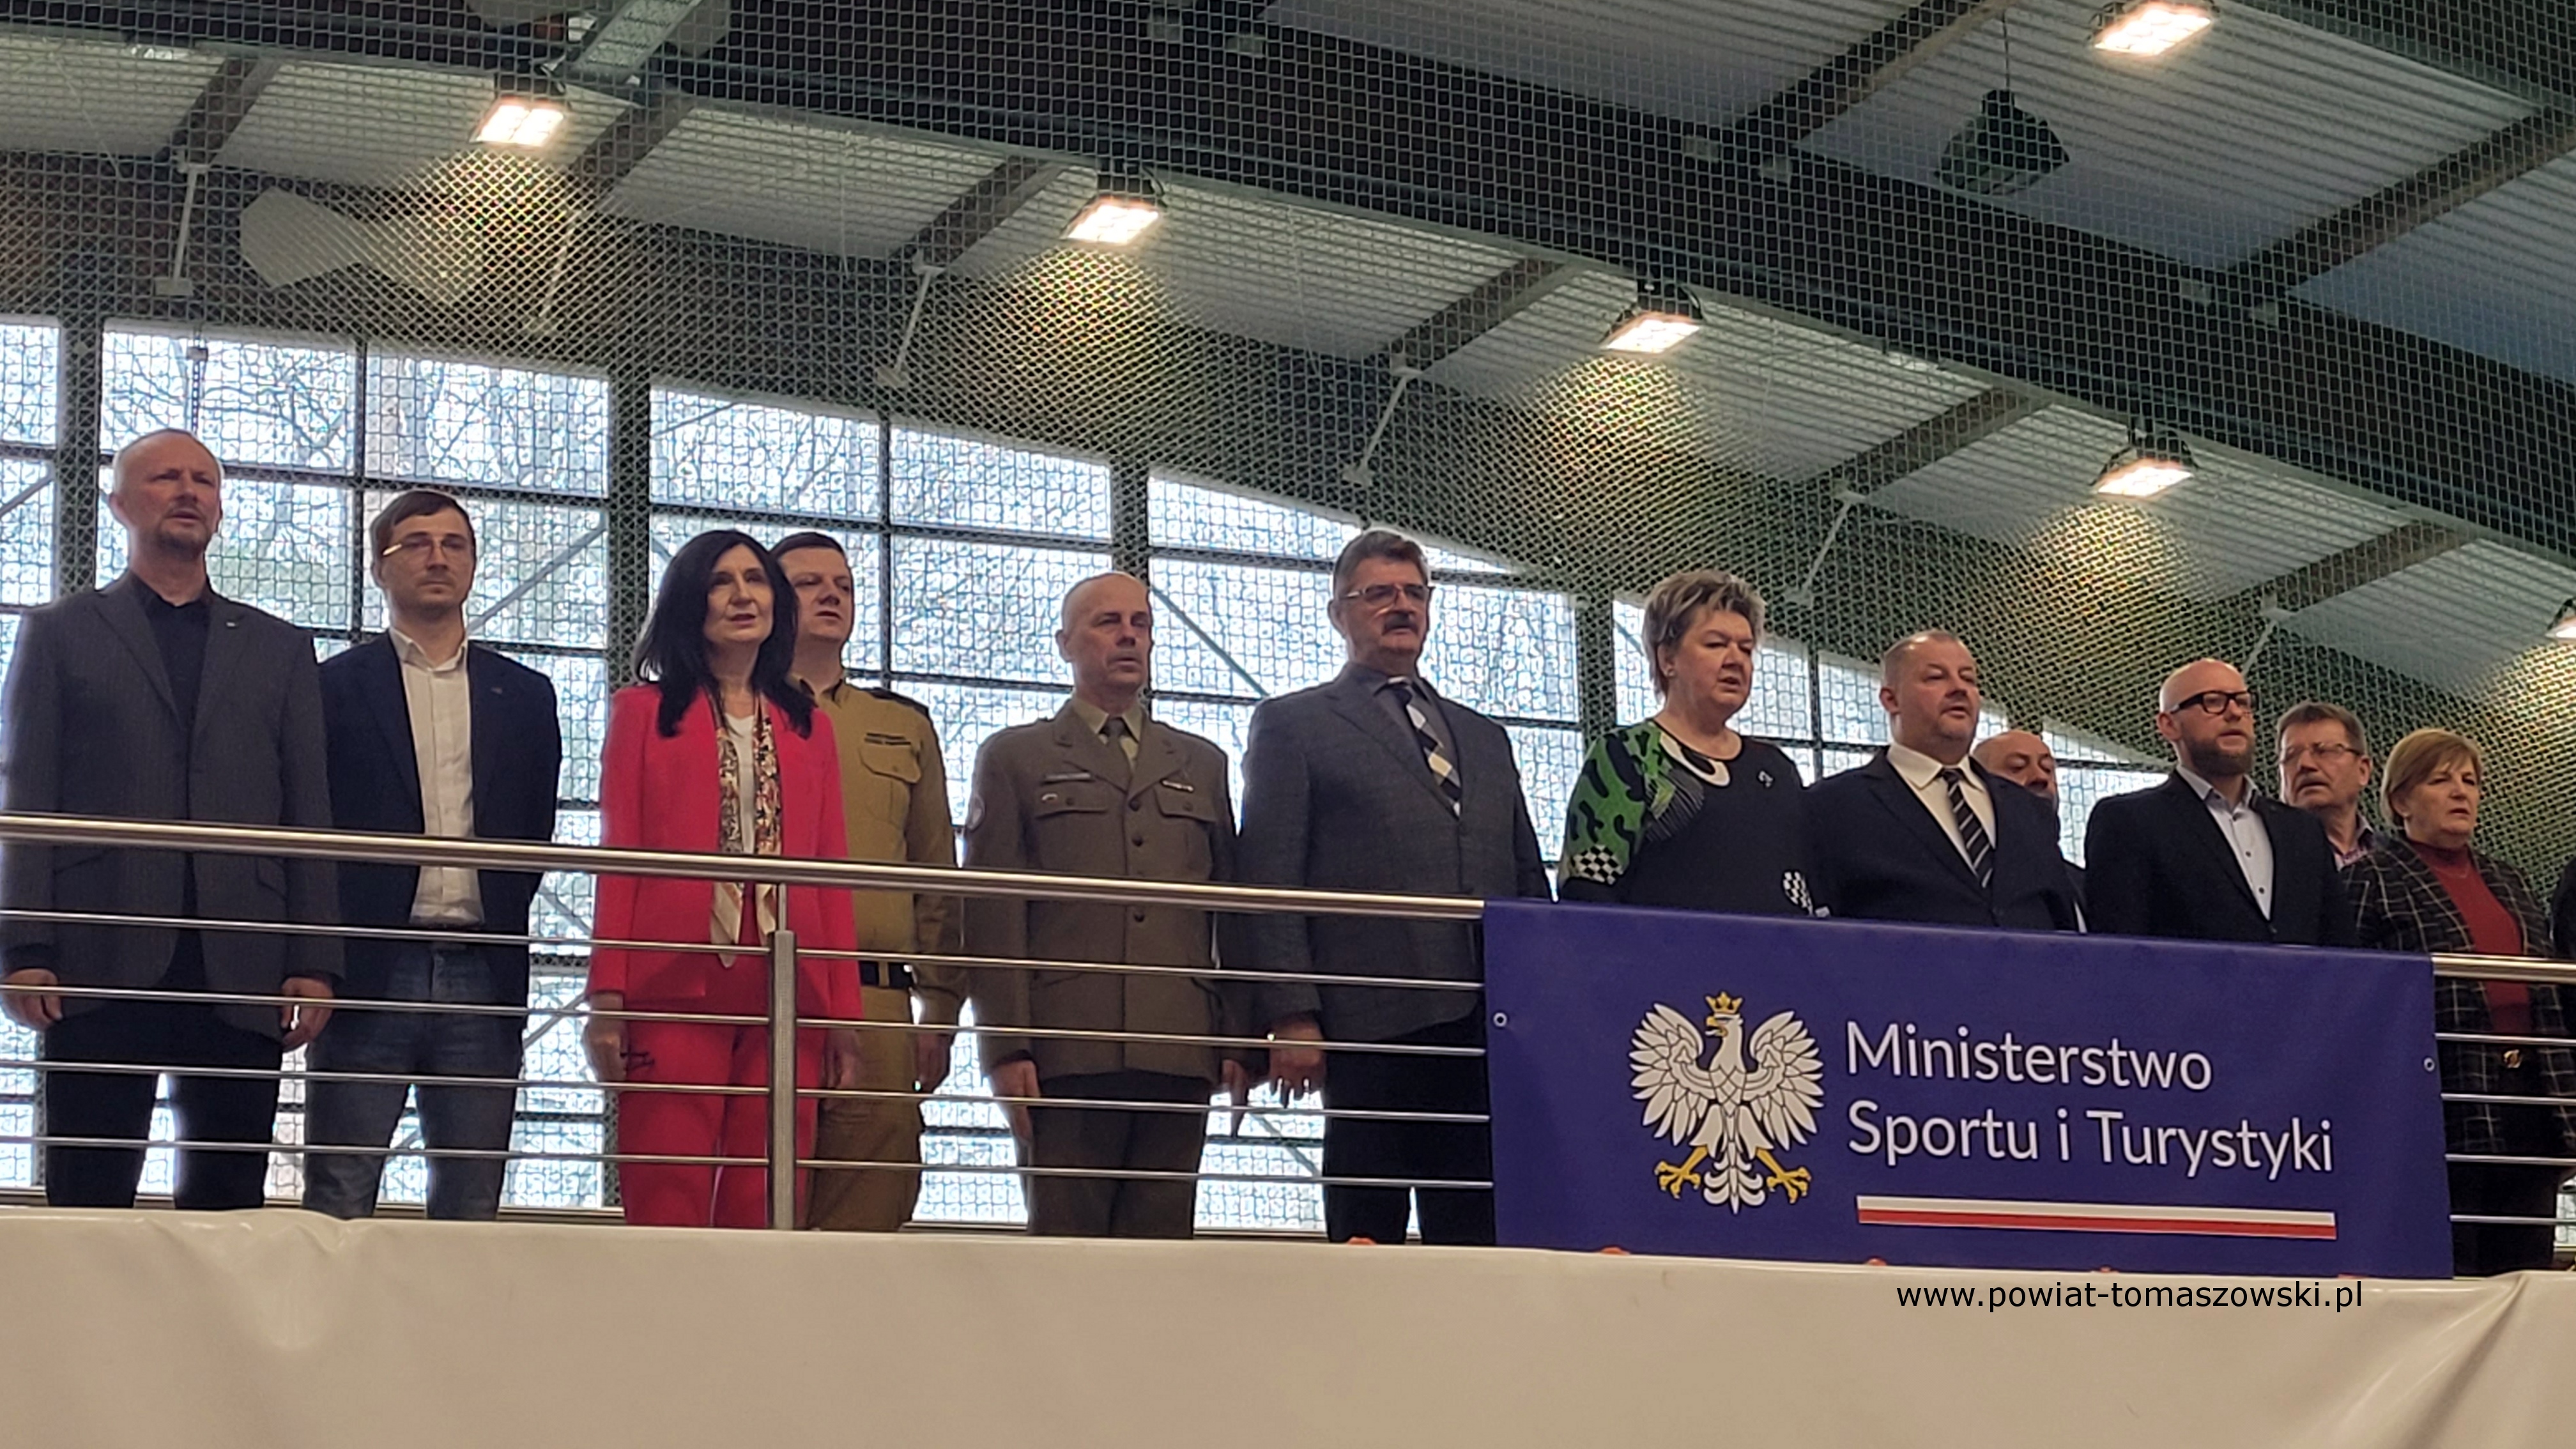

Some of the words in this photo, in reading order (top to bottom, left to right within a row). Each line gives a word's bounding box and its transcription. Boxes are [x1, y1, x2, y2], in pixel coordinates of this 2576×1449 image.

[1846, 1021, 2212, 1091] Ministerstwo
[1848, 1100, 2038, 1167] Sportu
[2057, 1108, 2069, 1161] i
[2085, 1110, 2333, 1181] Turystyki
